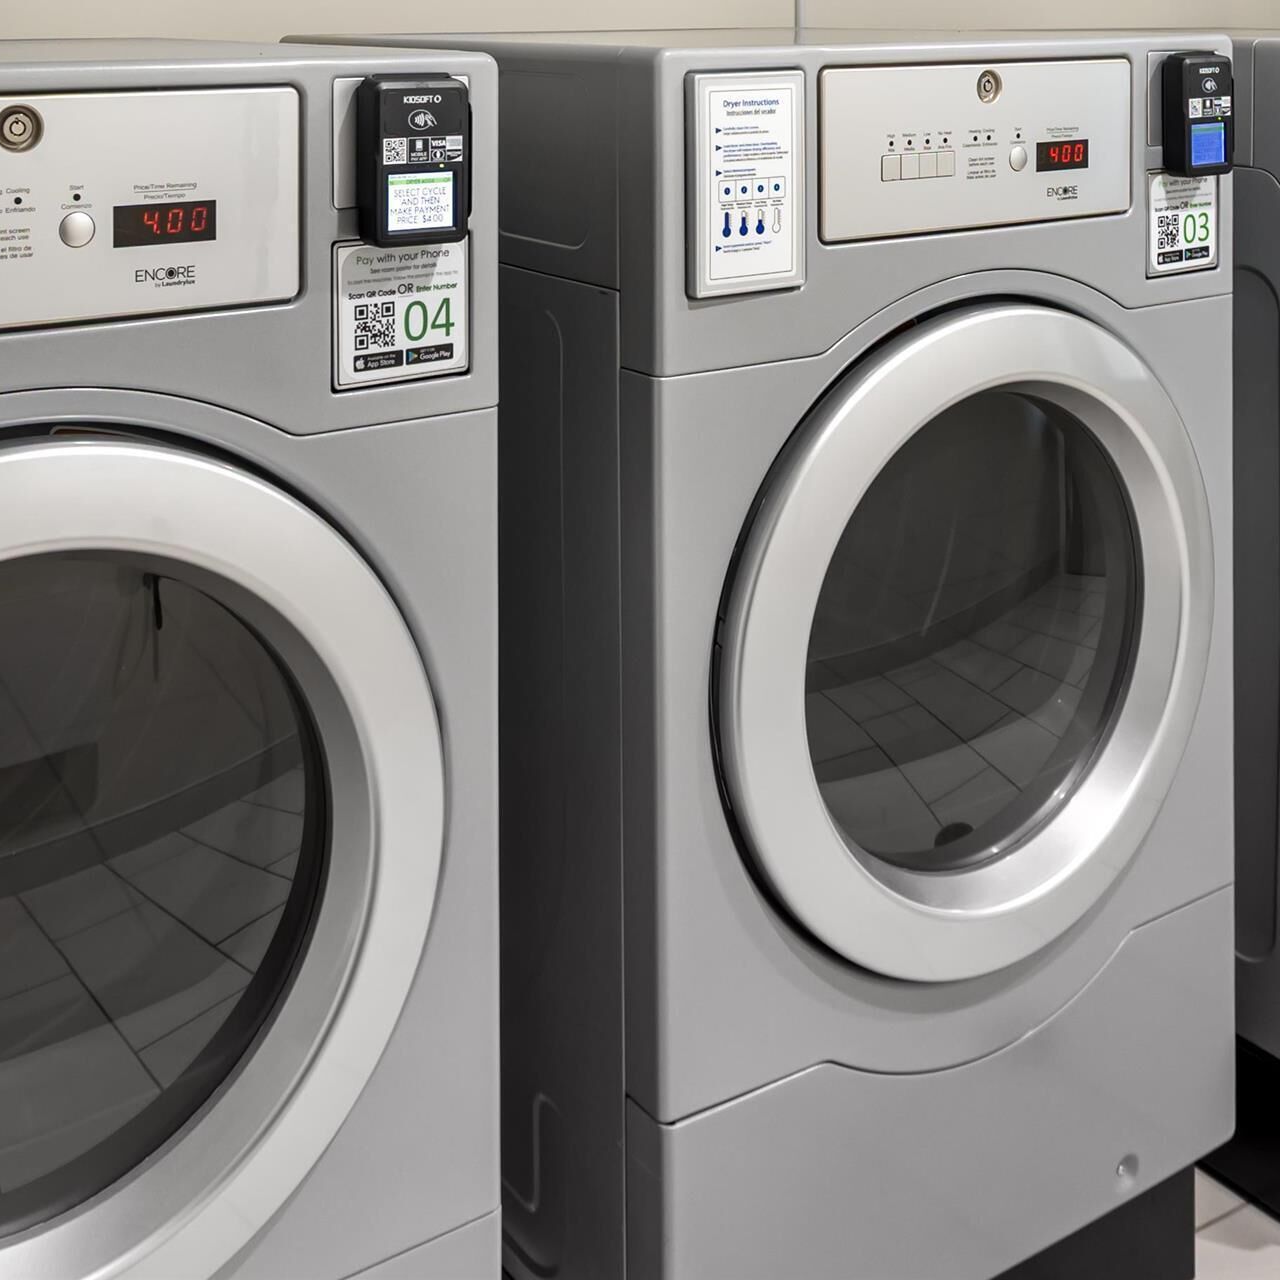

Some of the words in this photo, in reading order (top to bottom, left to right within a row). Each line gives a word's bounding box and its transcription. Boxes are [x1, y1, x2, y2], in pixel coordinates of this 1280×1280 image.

[723, 99, 741, 109] Dryer
[742, 99, 780, 107] Instructions
[166, 182, 197, 190] Remaining
[1047, 185, 1078, 197] ENCORE
[393, 188, 420, 198] SELECT
[422, 187, 447, 196] CYCLE
[401, 198, 419, 206] AND
[420, 196, 440, 205] THEN
[390, 207, 412, 216] MAKE
[414, 204, 450, 214] PAYMENT
[143, 206, 208, 234] 4.00
[1183, 212, 1209, 244] 03
[356, 256, 376, 266] Pay
[377, 253, 396, 263] with
[398, 252, 418, 263] your
[420, 248, 450, 259] Phone
[134, 265, 196, 283] ENCORE
[348, 291, 366, 300] Scan
[366, 289, 377, 298] QR
[378, 288, 396, 296] Code
[397, 283, 414, 295] OR
[416, 285, 432, 293] Enter
[433, 282, 458, 291] Number
[404, 297, 455, 341] 04
[420, 351, 439, 360] Google
[439, 350, 451, 358] Play
[367, 360, 379, 368] App
[380, 358, 396, 366] Store
